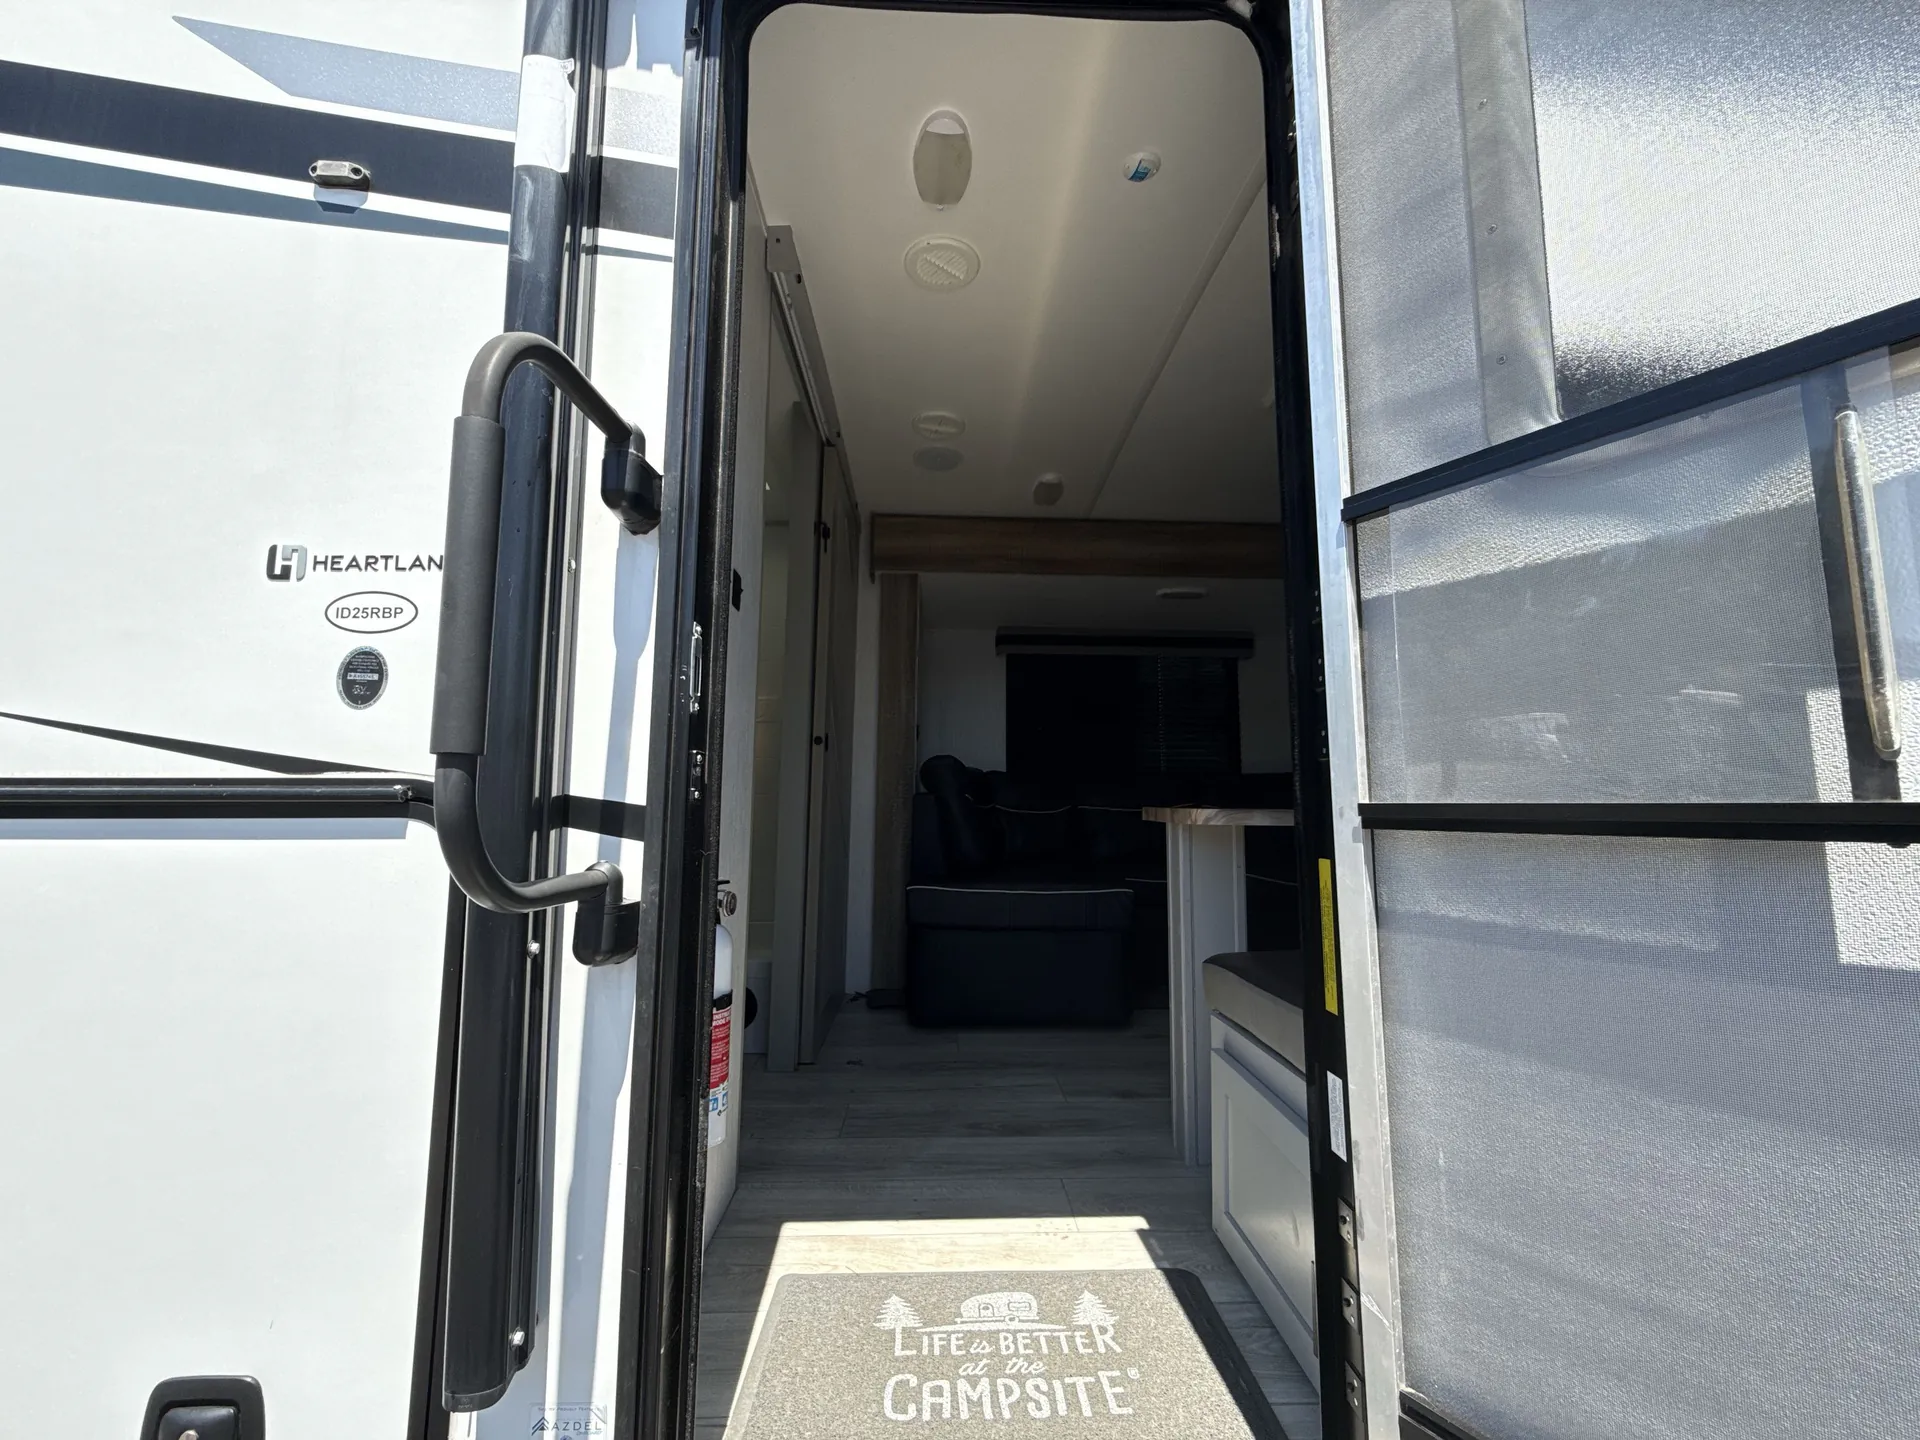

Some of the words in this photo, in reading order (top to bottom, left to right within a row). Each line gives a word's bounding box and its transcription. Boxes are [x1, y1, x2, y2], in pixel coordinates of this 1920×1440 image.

[336, 607, 404, 619] ID25RBP
[894, 1327, 968, 1356] LIFE
[969, 1338, 994, 1355] is
[999, 1325, 1122, 1356] BETTER
[958, 1358, 990, 1376] at
[1004, 1357, 1047, 1375] the
[551, 1421, 602, 1431] AZDEL
